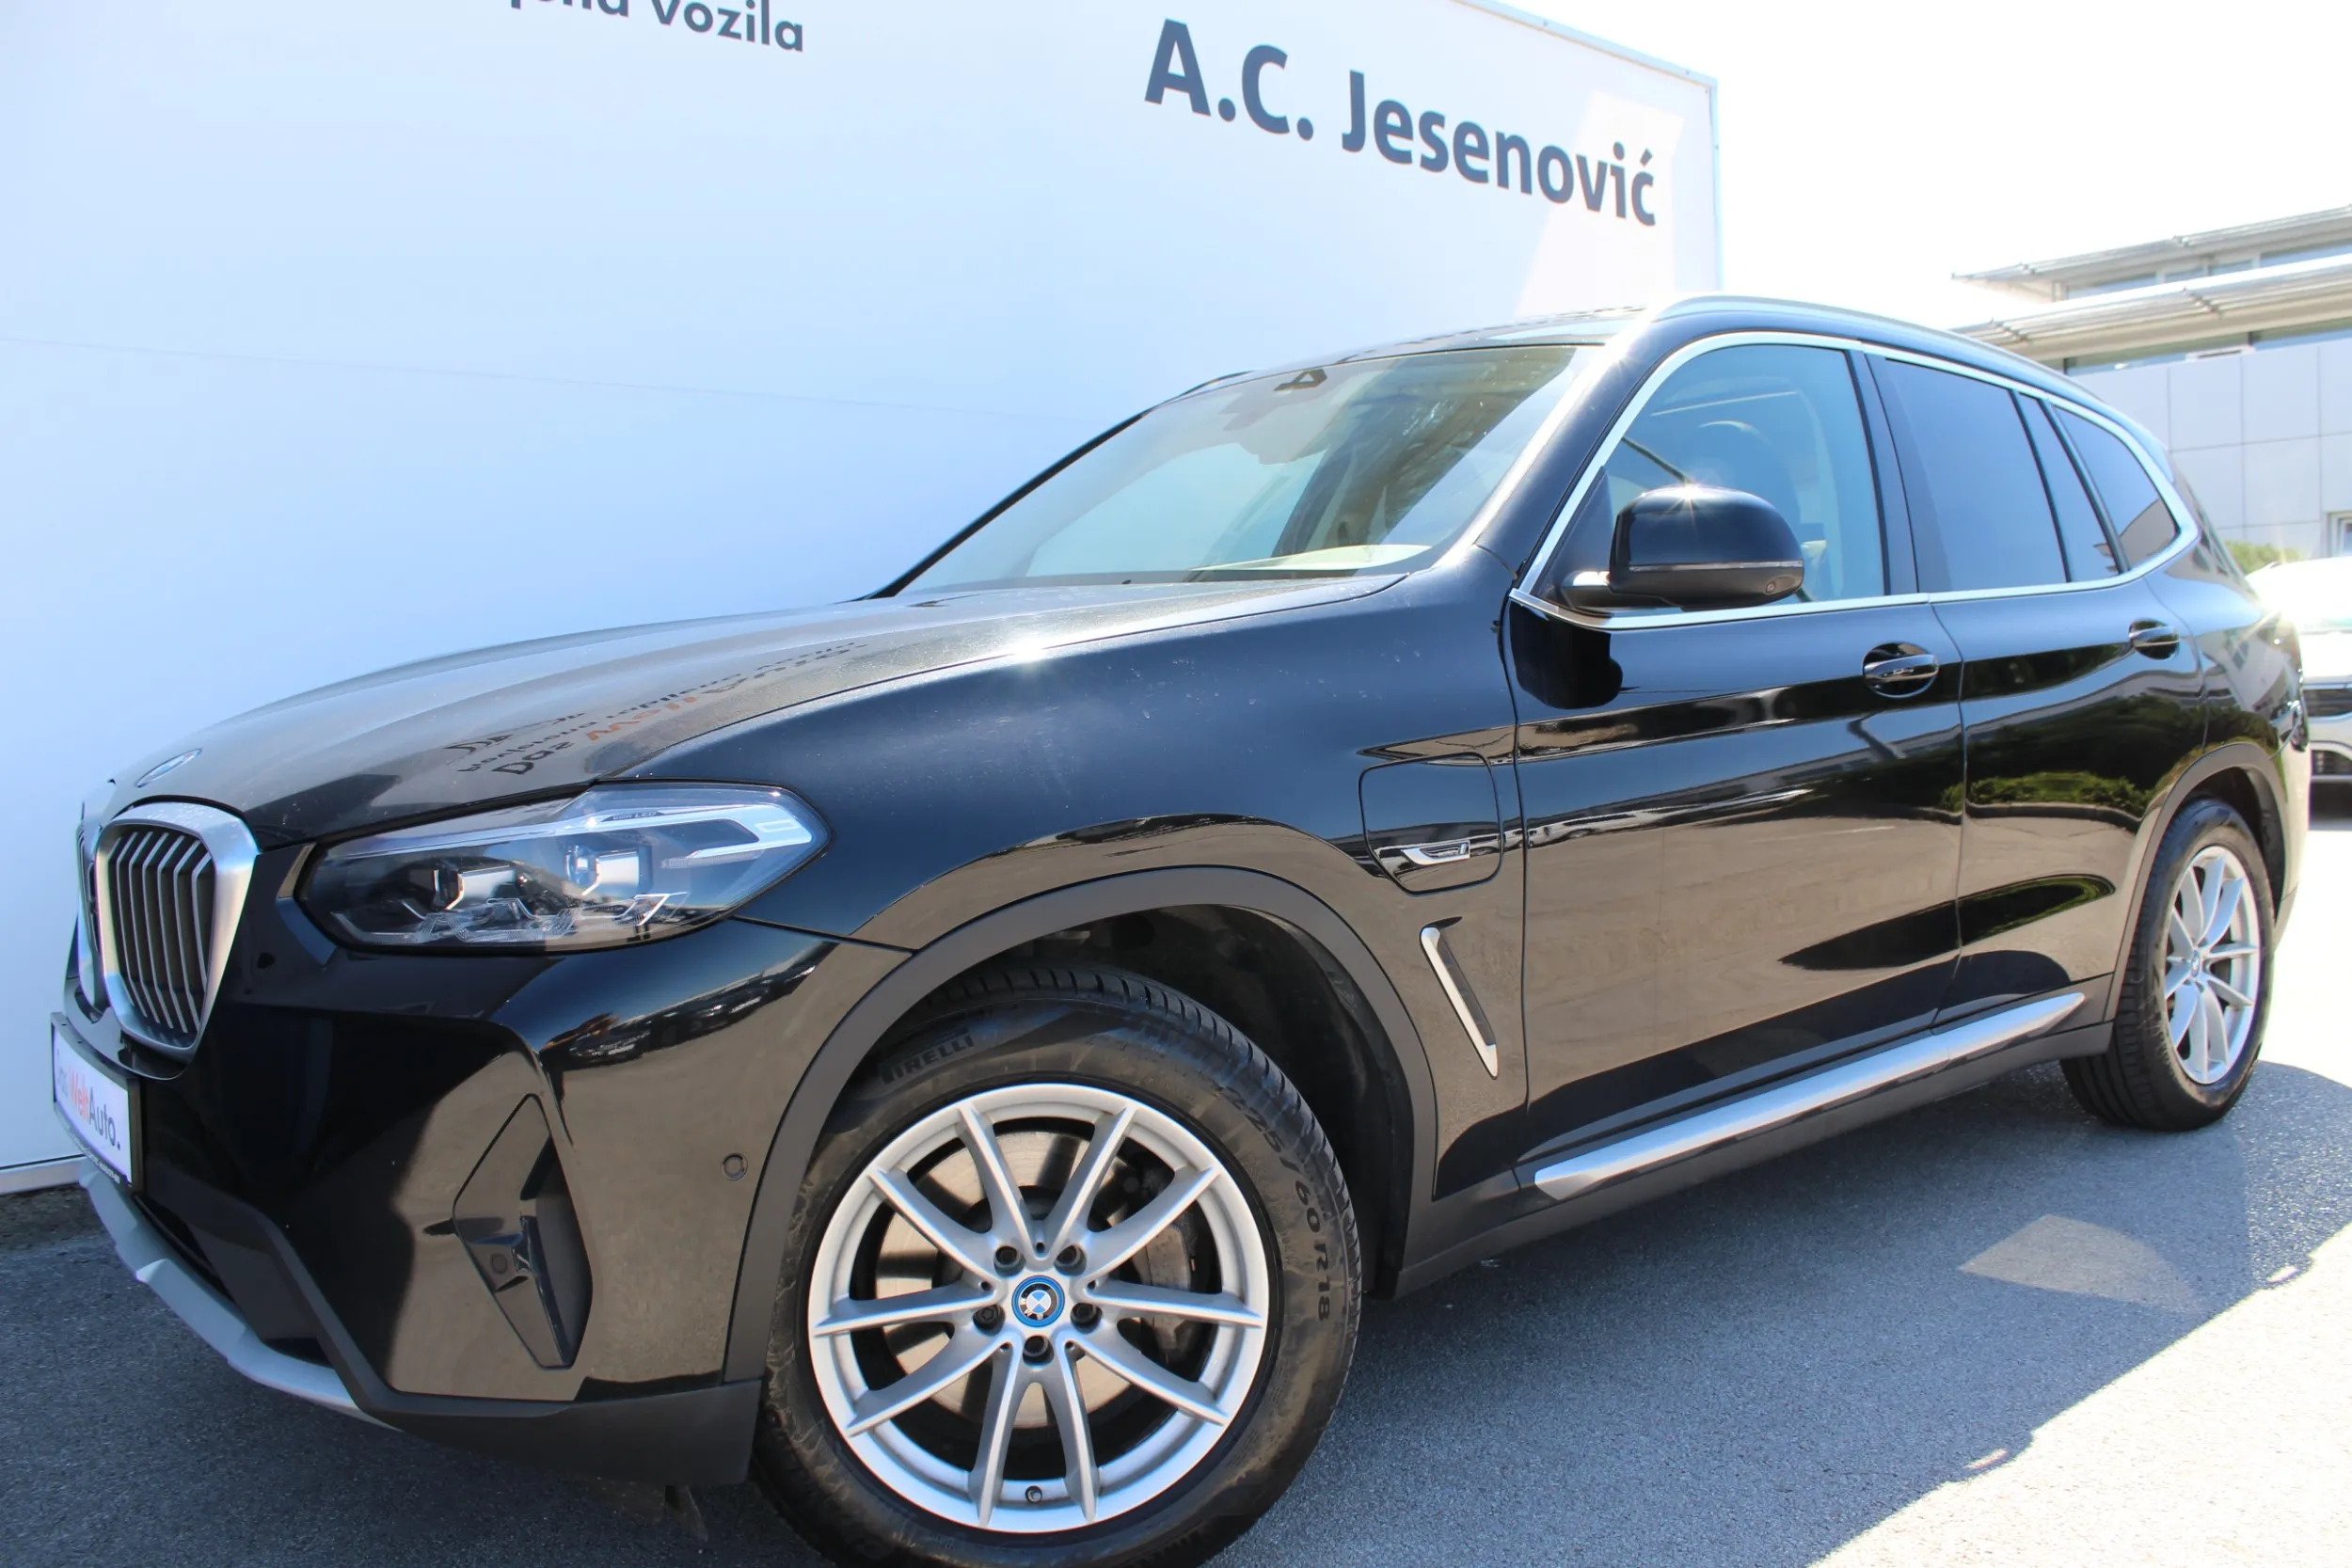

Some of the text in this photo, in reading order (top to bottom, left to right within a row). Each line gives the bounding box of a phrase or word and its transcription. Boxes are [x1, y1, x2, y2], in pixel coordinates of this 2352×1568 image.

[651, 0, 804, 53] vozila
[1144, 18, 1656, 227] A.C. Jesenović
[882, 1027, 975, 1085] PIRELLI
